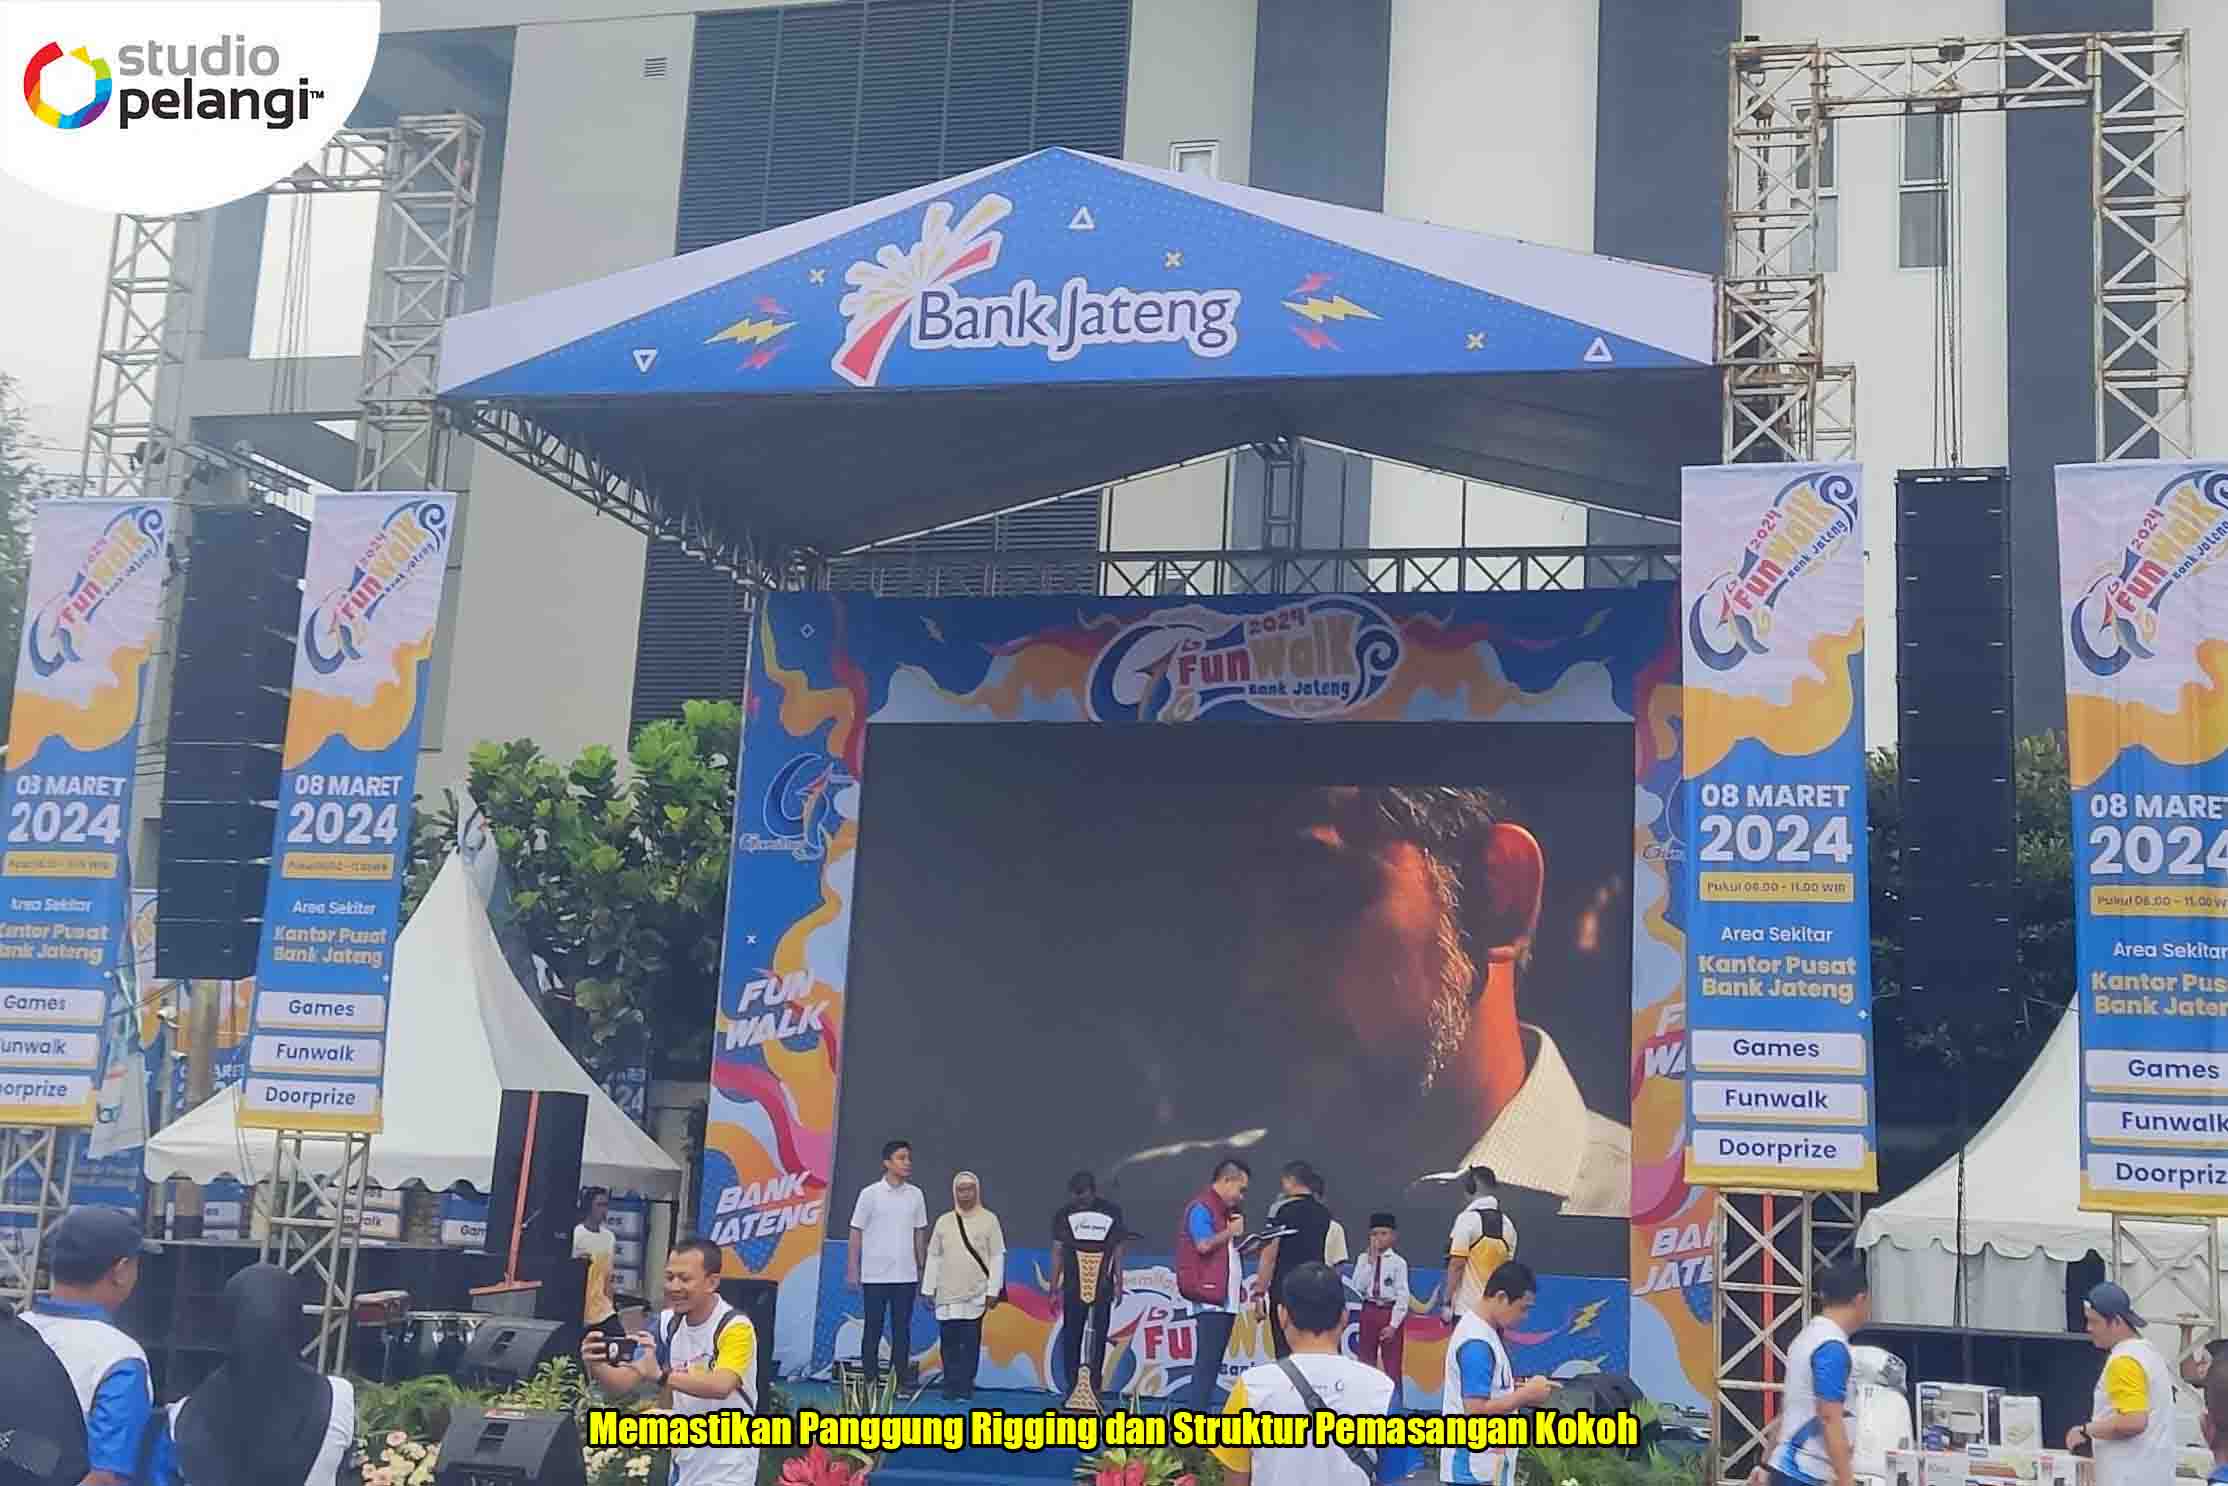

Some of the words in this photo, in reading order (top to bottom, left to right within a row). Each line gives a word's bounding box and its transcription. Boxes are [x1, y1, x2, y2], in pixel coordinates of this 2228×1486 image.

[1750, 508, 1783, 550] 2024
[2131, 507, 2164, 550] 2024
[44, 775, 127, 796] MARET
[295, 774, 326, 796] 08
[327, 775, 403, 796] MARET
[1701, 783, 1739, 808] 08
[1747, 784, 1851, 808] MARET
[2090, 792, 2128, 819] 08
[8, 801, 121, 845] 2024
[286, 801, 401, 845] 2024
[1699, 814, 1853, 864] 2024
[2088, 825, 2228, 876] 2024
[1720, 927, 1765, 942] Area
[1769, 926, 1833, 943] Sekitar
[2113, 941, 2157, 957] Area
[1698, 955, 1782, 974] Kantor
[1786, 956, 1857, 976] Pusat
[737, 968, 814, 1013] FUN
[1702, 977, 1763, 997] Bank
[1768, 979, 1855, 1006] Jateng
[2092, 971, 2177, 992] Kantor
[2182, 973, 2228, 993] Pus
[4, 995, 66, 1011] Games
[289, 999, 356, 1016] Games
[2095, 995, 2161, 1016] Bank
[726, 1000, 830, 1050] WALK
[0, 1038, 66, 1056] unwalk
[276, 1043, 356, 1062] Funwalk
[1733, 1038, 1820, 1058] Games
[2128, 1059, 2220, 1079] Games
[0, 1080, 68, 1102] orprize
[265, 1086, 357, 1110] Doorprize
[1725, 1089, 1829, 1110] Funwalk
[1719, 1138, 1838, 1164] Doorprize
[2115, 1162, 2228, 1191] Doorpriz
[716, 1168, 812, 1215] BANK
[1143, 1324, 1193, 1361] Fu
